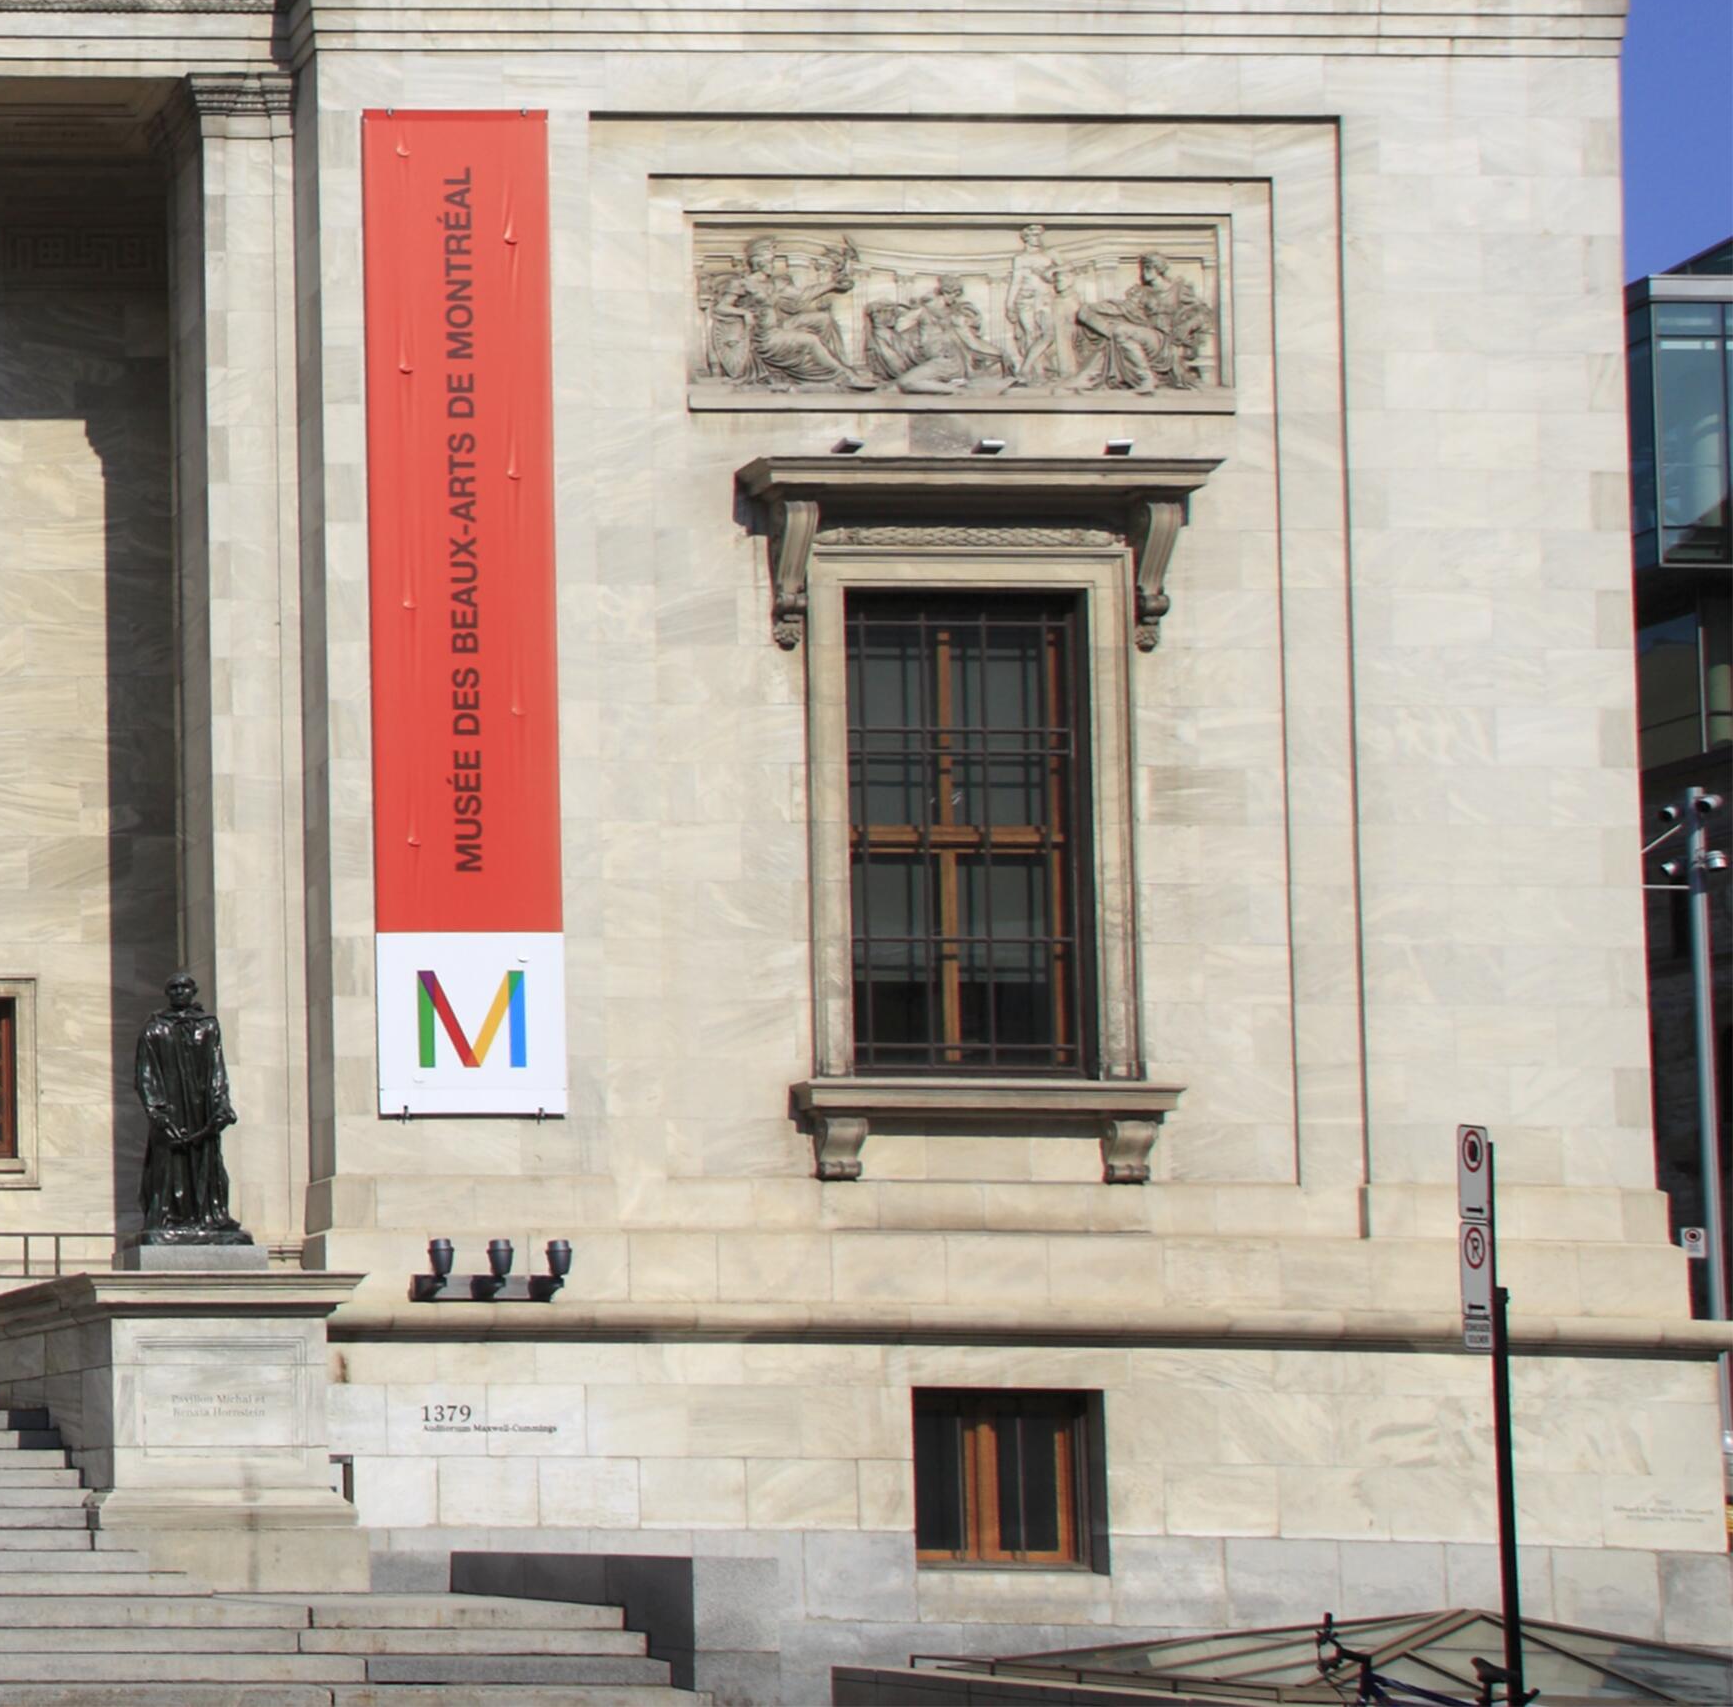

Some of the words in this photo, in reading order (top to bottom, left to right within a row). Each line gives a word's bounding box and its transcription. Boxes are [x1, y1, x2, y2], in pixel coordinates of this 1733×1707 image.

[437, 167, 475, 360] MONTRÉAL
[446, 373, 476, 419] DE
[448, 432, 481, 654] BEAUX-ARTS
[450, 666, 482, 737] DES
[447, 750, 484, 874] MUSÉE
[417, 970, 528, 1069] M
[422, 1404, 472, 1423] 1379
[422, 1423, 472, 1433] Auditorium
[473, 1423, 558, 1434] Maxwell-Cummings
